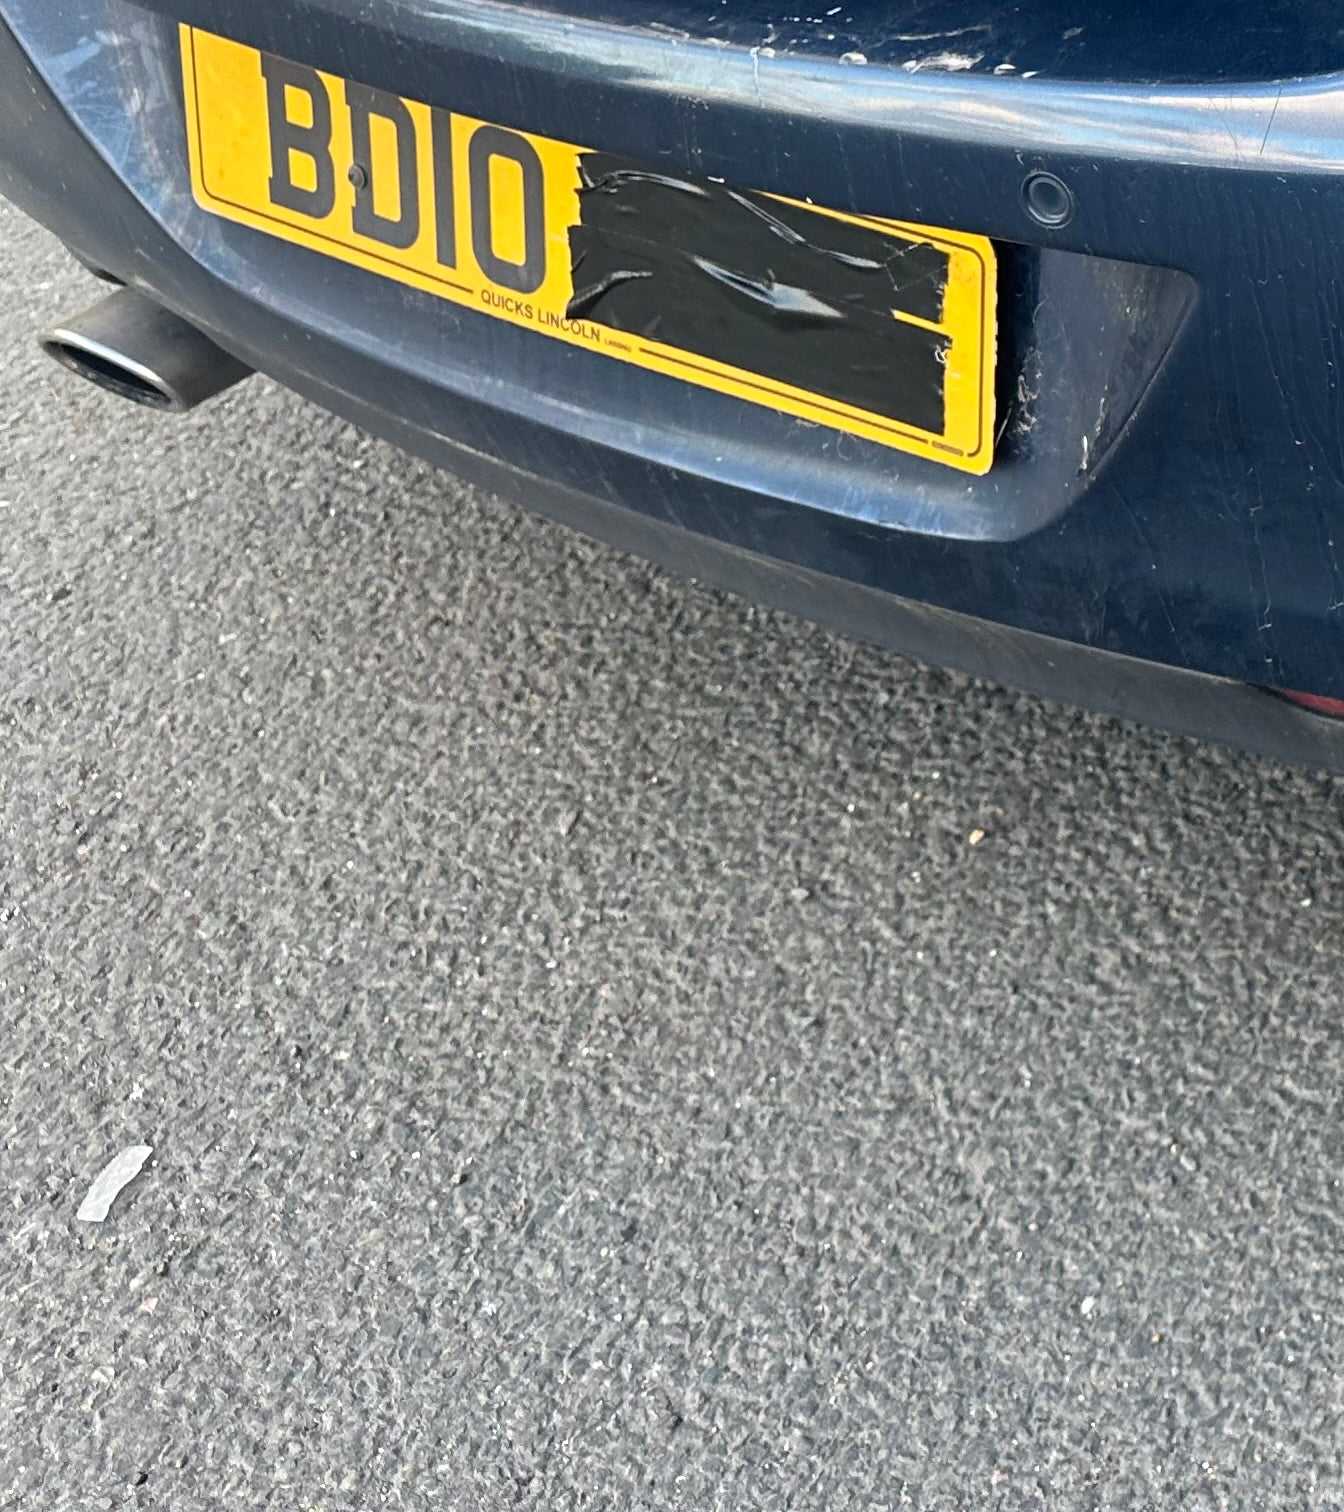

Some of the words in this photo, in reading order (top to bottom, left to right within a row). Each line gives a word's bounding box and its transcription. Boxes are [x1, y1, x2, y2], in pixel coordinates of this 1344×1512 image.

[260, 50, 548, 295] BD10
[481, 288, 533, 320] QUICKS
[537, 307, 601, 342] LINCOLN
